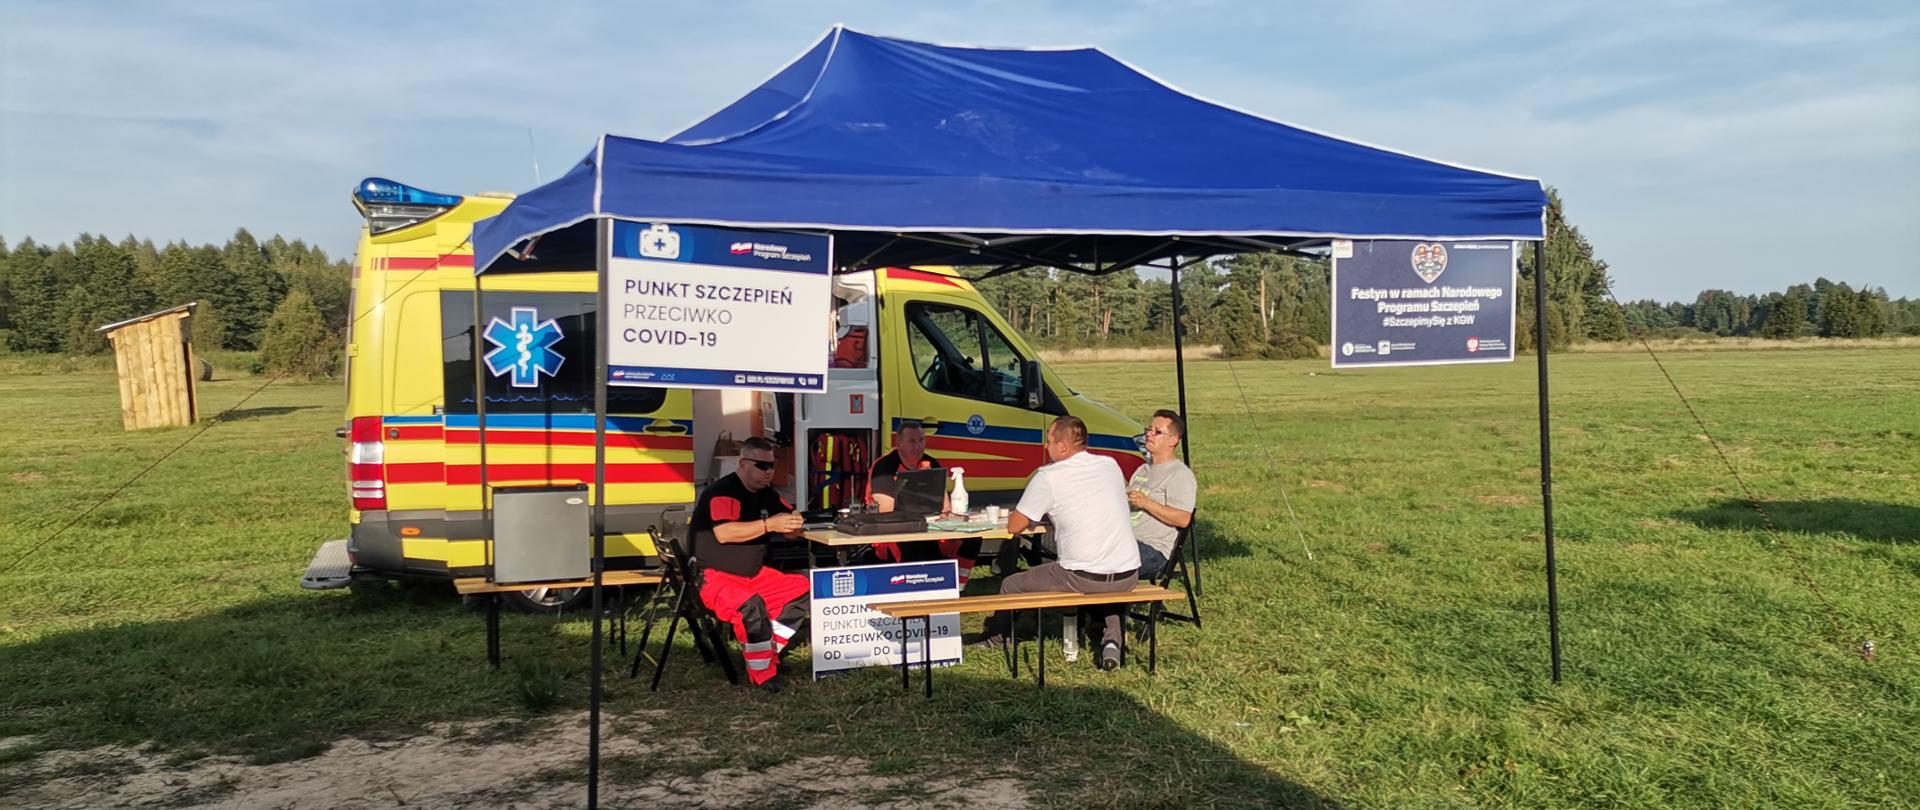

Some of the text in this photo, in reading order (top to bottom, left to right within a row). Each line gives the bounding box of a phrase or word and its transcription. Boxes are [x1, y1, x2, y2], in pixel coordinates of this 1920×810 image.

[625, 279, 793, 305] PUNKT SZCZEPIEŃ
[1351, 286, 1503, 301] Festyn w ramach Narodowego
[623, 303, 733, 325] PRZECIWKO
[1377, 300, 1480, 315] Programu Szczepień
[1383, 315, 1476, 328] #SzczepimySię z KGW
[623, 328, 718, 347] COVID-19
[822, 604, 873, 616] GODZIN
[823, 618, 867, 631] PUNKTU
[823, 626, 949, 645] PRZECIWKO COVI-19
[823, 646, 890, 661] OD DO
